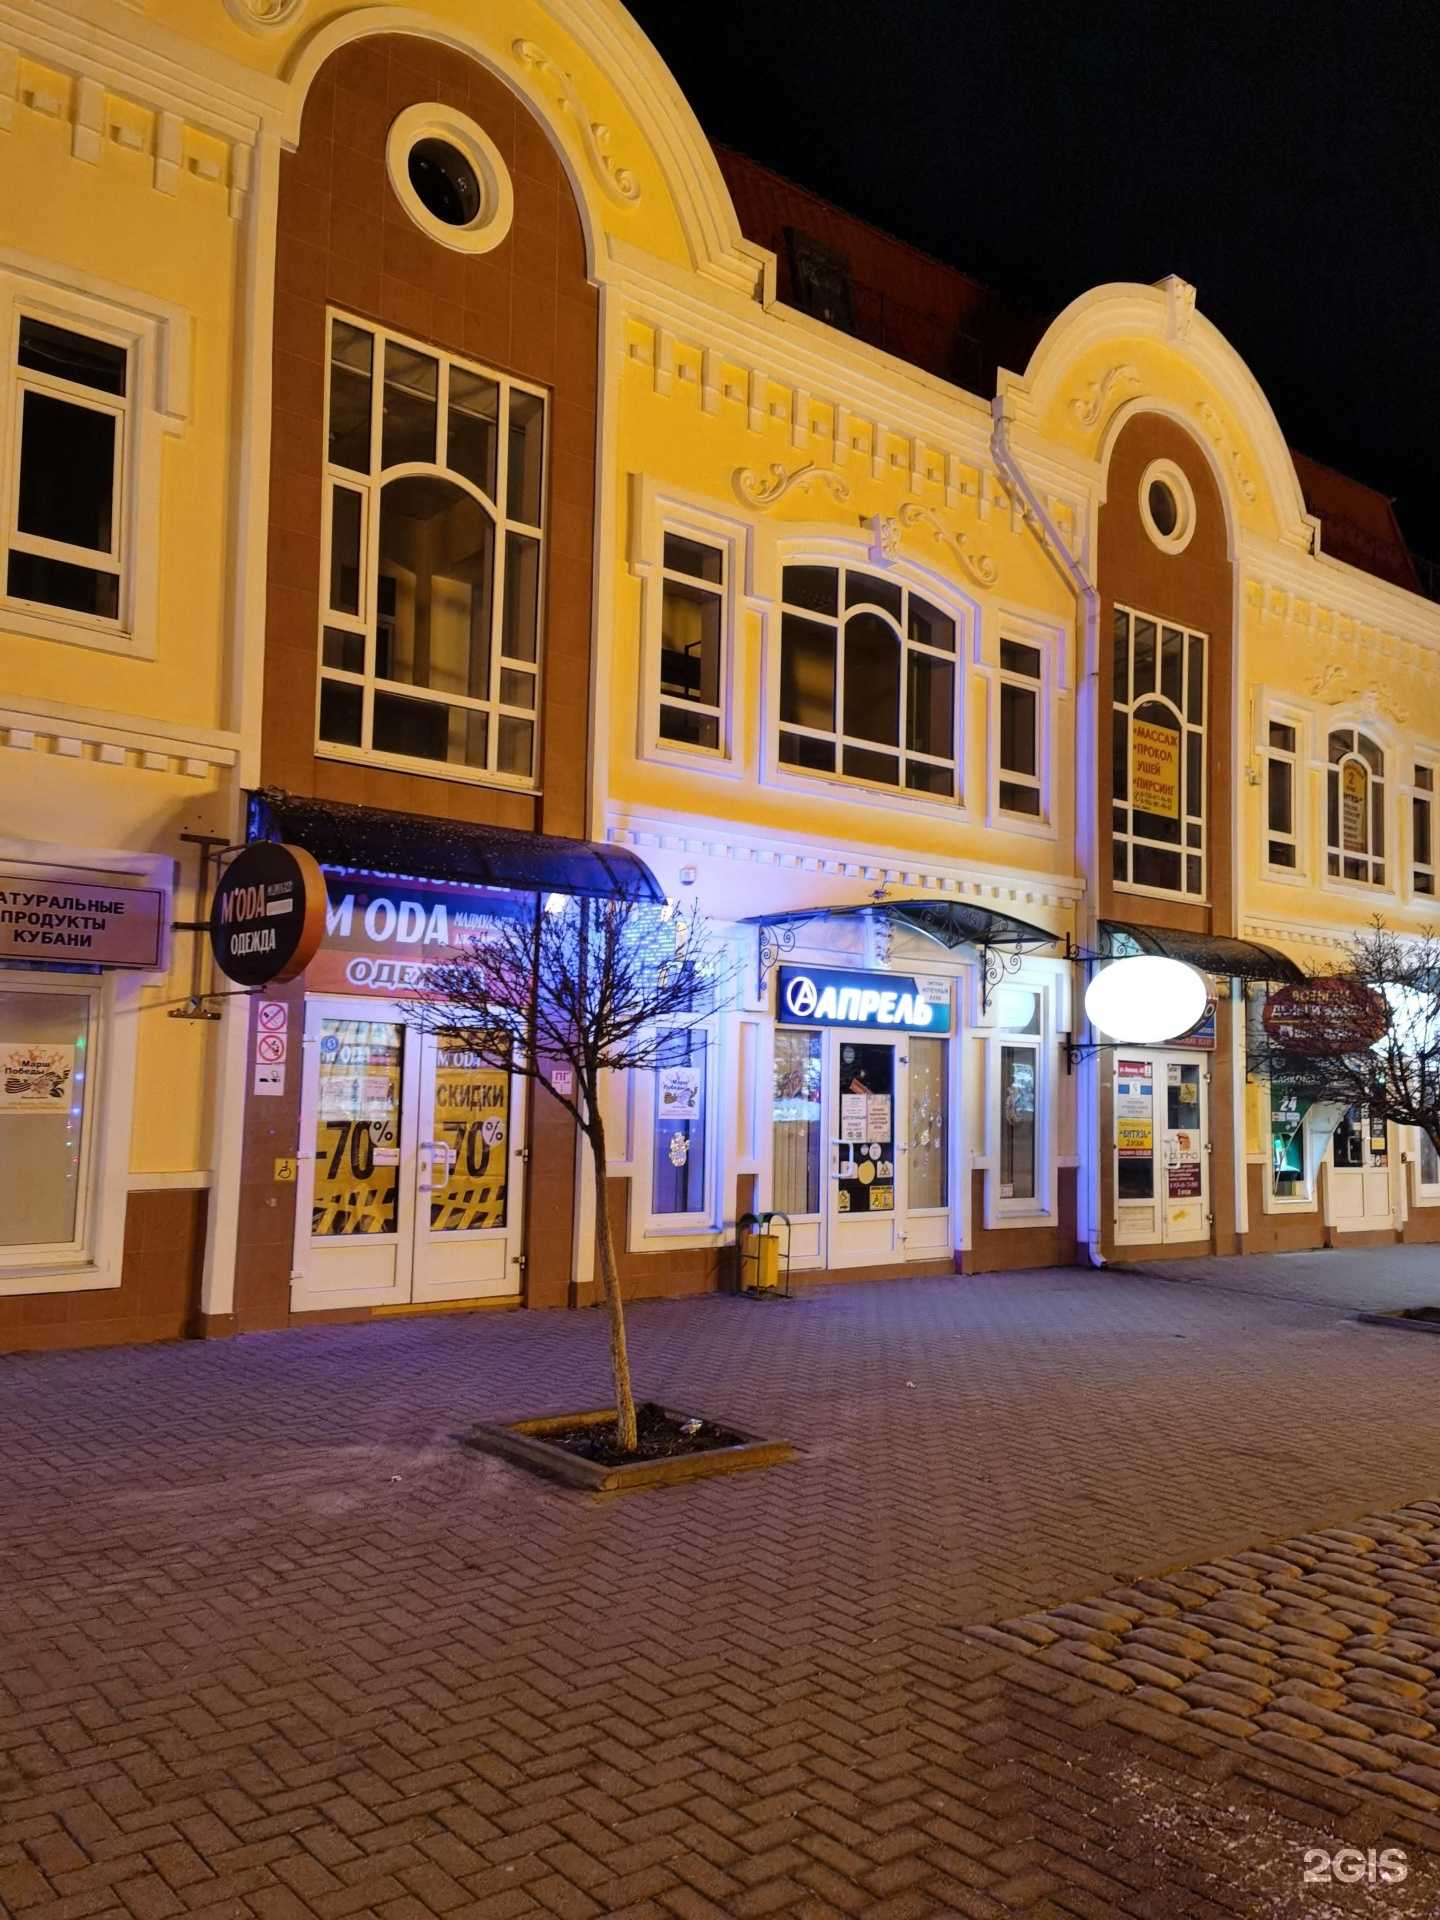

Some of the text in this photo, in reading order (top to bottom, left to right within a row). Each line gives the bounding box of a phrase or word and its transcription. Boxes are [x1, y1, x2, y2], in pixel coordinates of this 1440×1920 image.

[1, 910, 106, 931] ПРОДУКТЫ
[14, 929, 92, 947] КУБАНИ
[231, 928, 276, 956] ОДЕЖДА
[814, 986, 934, 1026] АПРЕЛЬ
[437, 1085, 504, 1111] СКИДКИ
